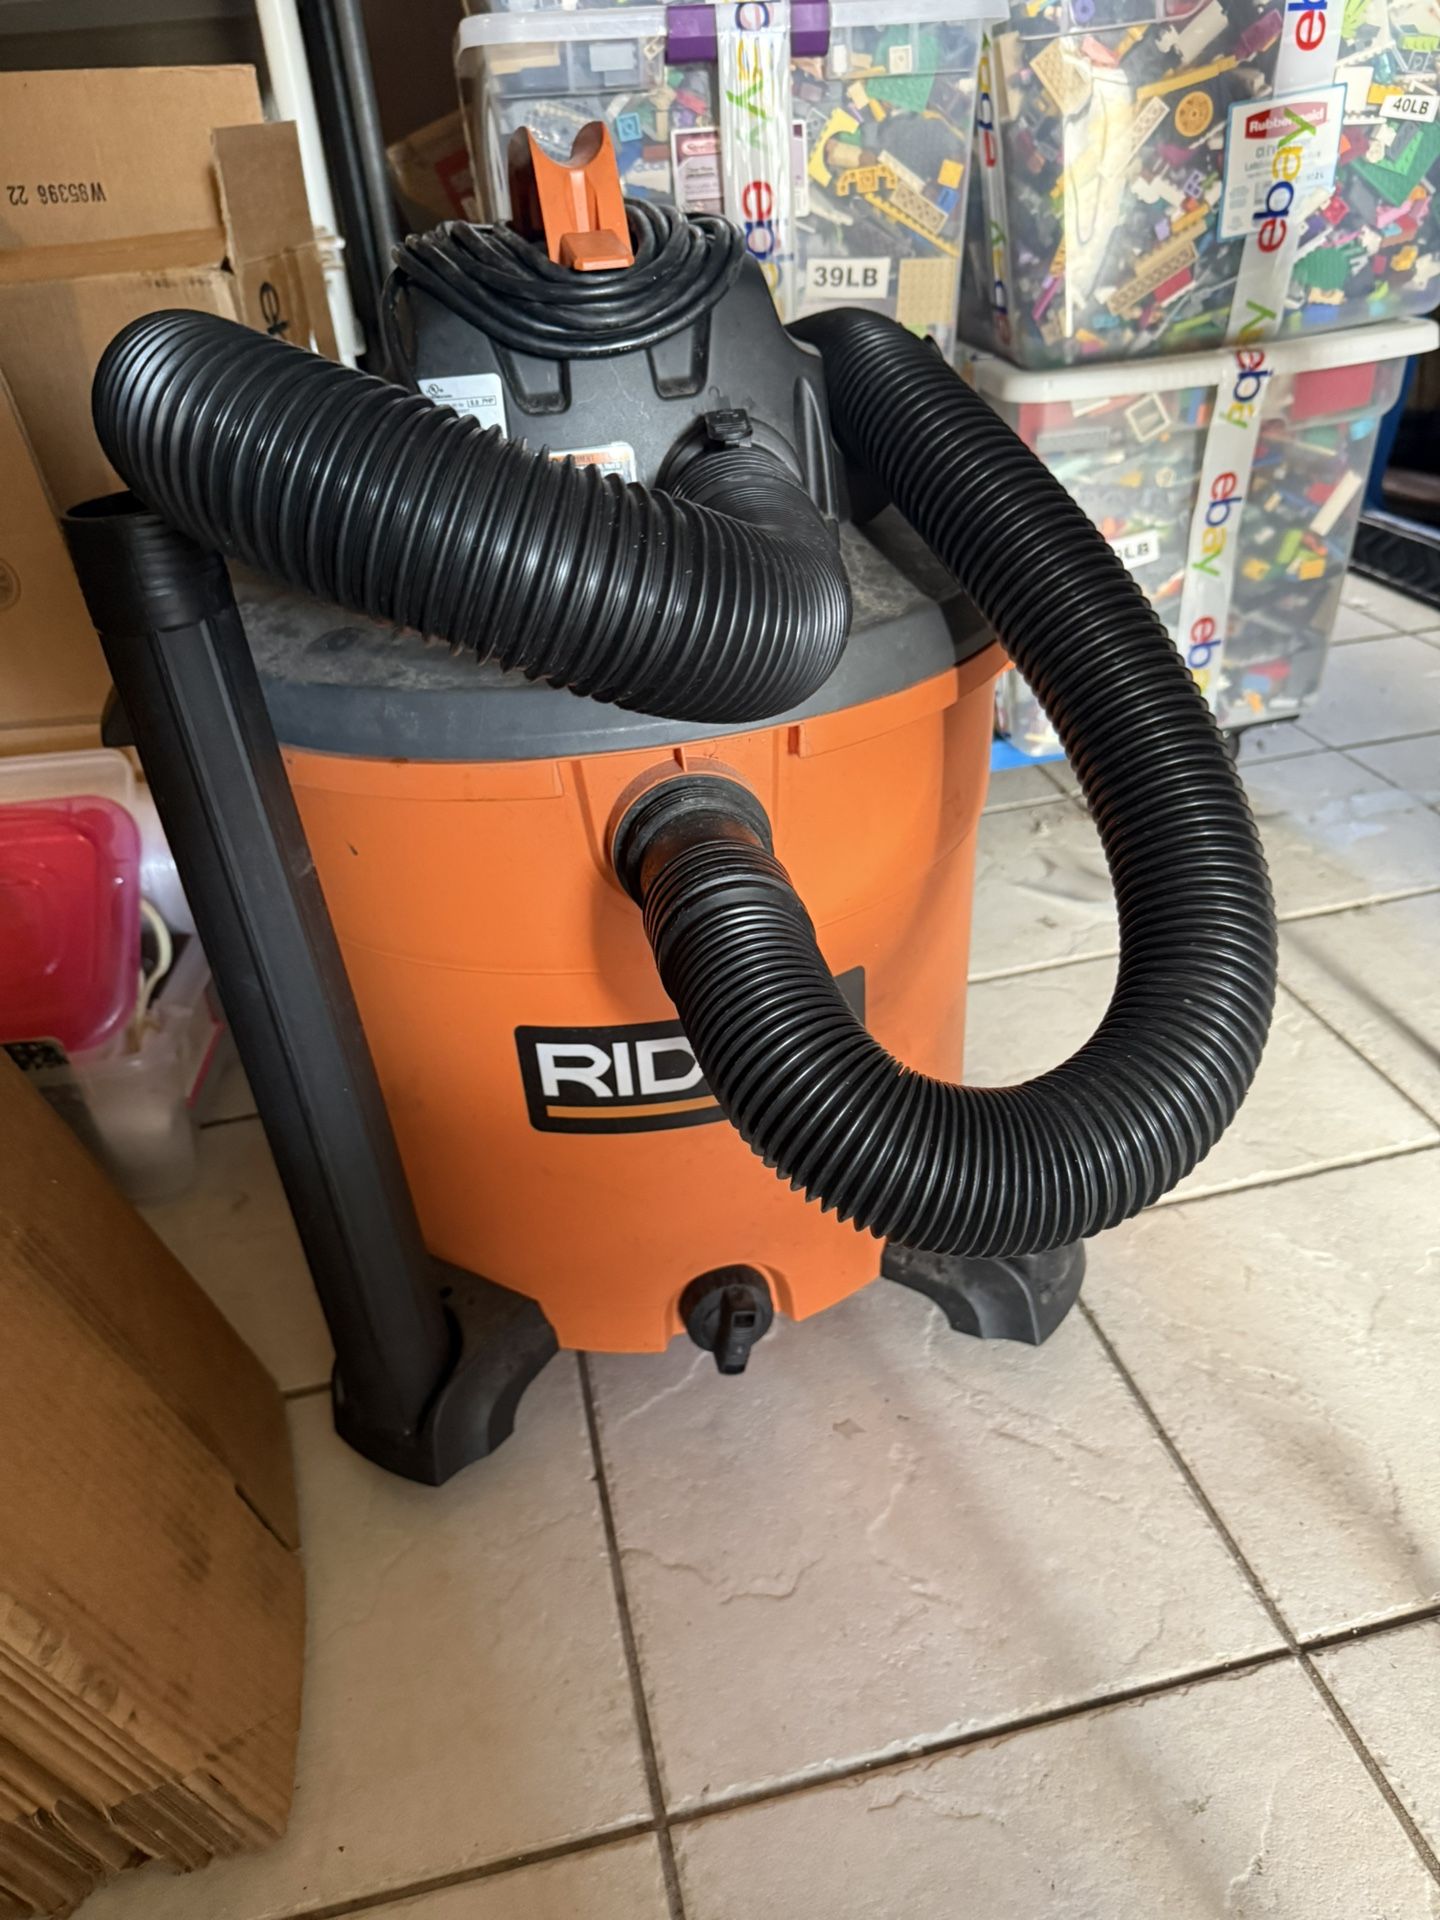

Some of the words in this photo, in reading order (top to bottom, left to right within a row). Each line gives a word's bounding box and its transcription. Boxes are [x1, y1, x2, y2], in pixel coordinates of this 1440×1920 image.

[1392, 97, 1430, 115] 40LB
[1250, 107, 1325, 134] Rubbeaid
[1252, 107, 1317, 254] ebay
[6, 184, 29, 206] 22
[37, 182, 107, 206] W85396
[812, 266, 878, 288] 39LB
[1191, 471, 1243, 577] ebay
[534, 1035, 706, 1098] RID
